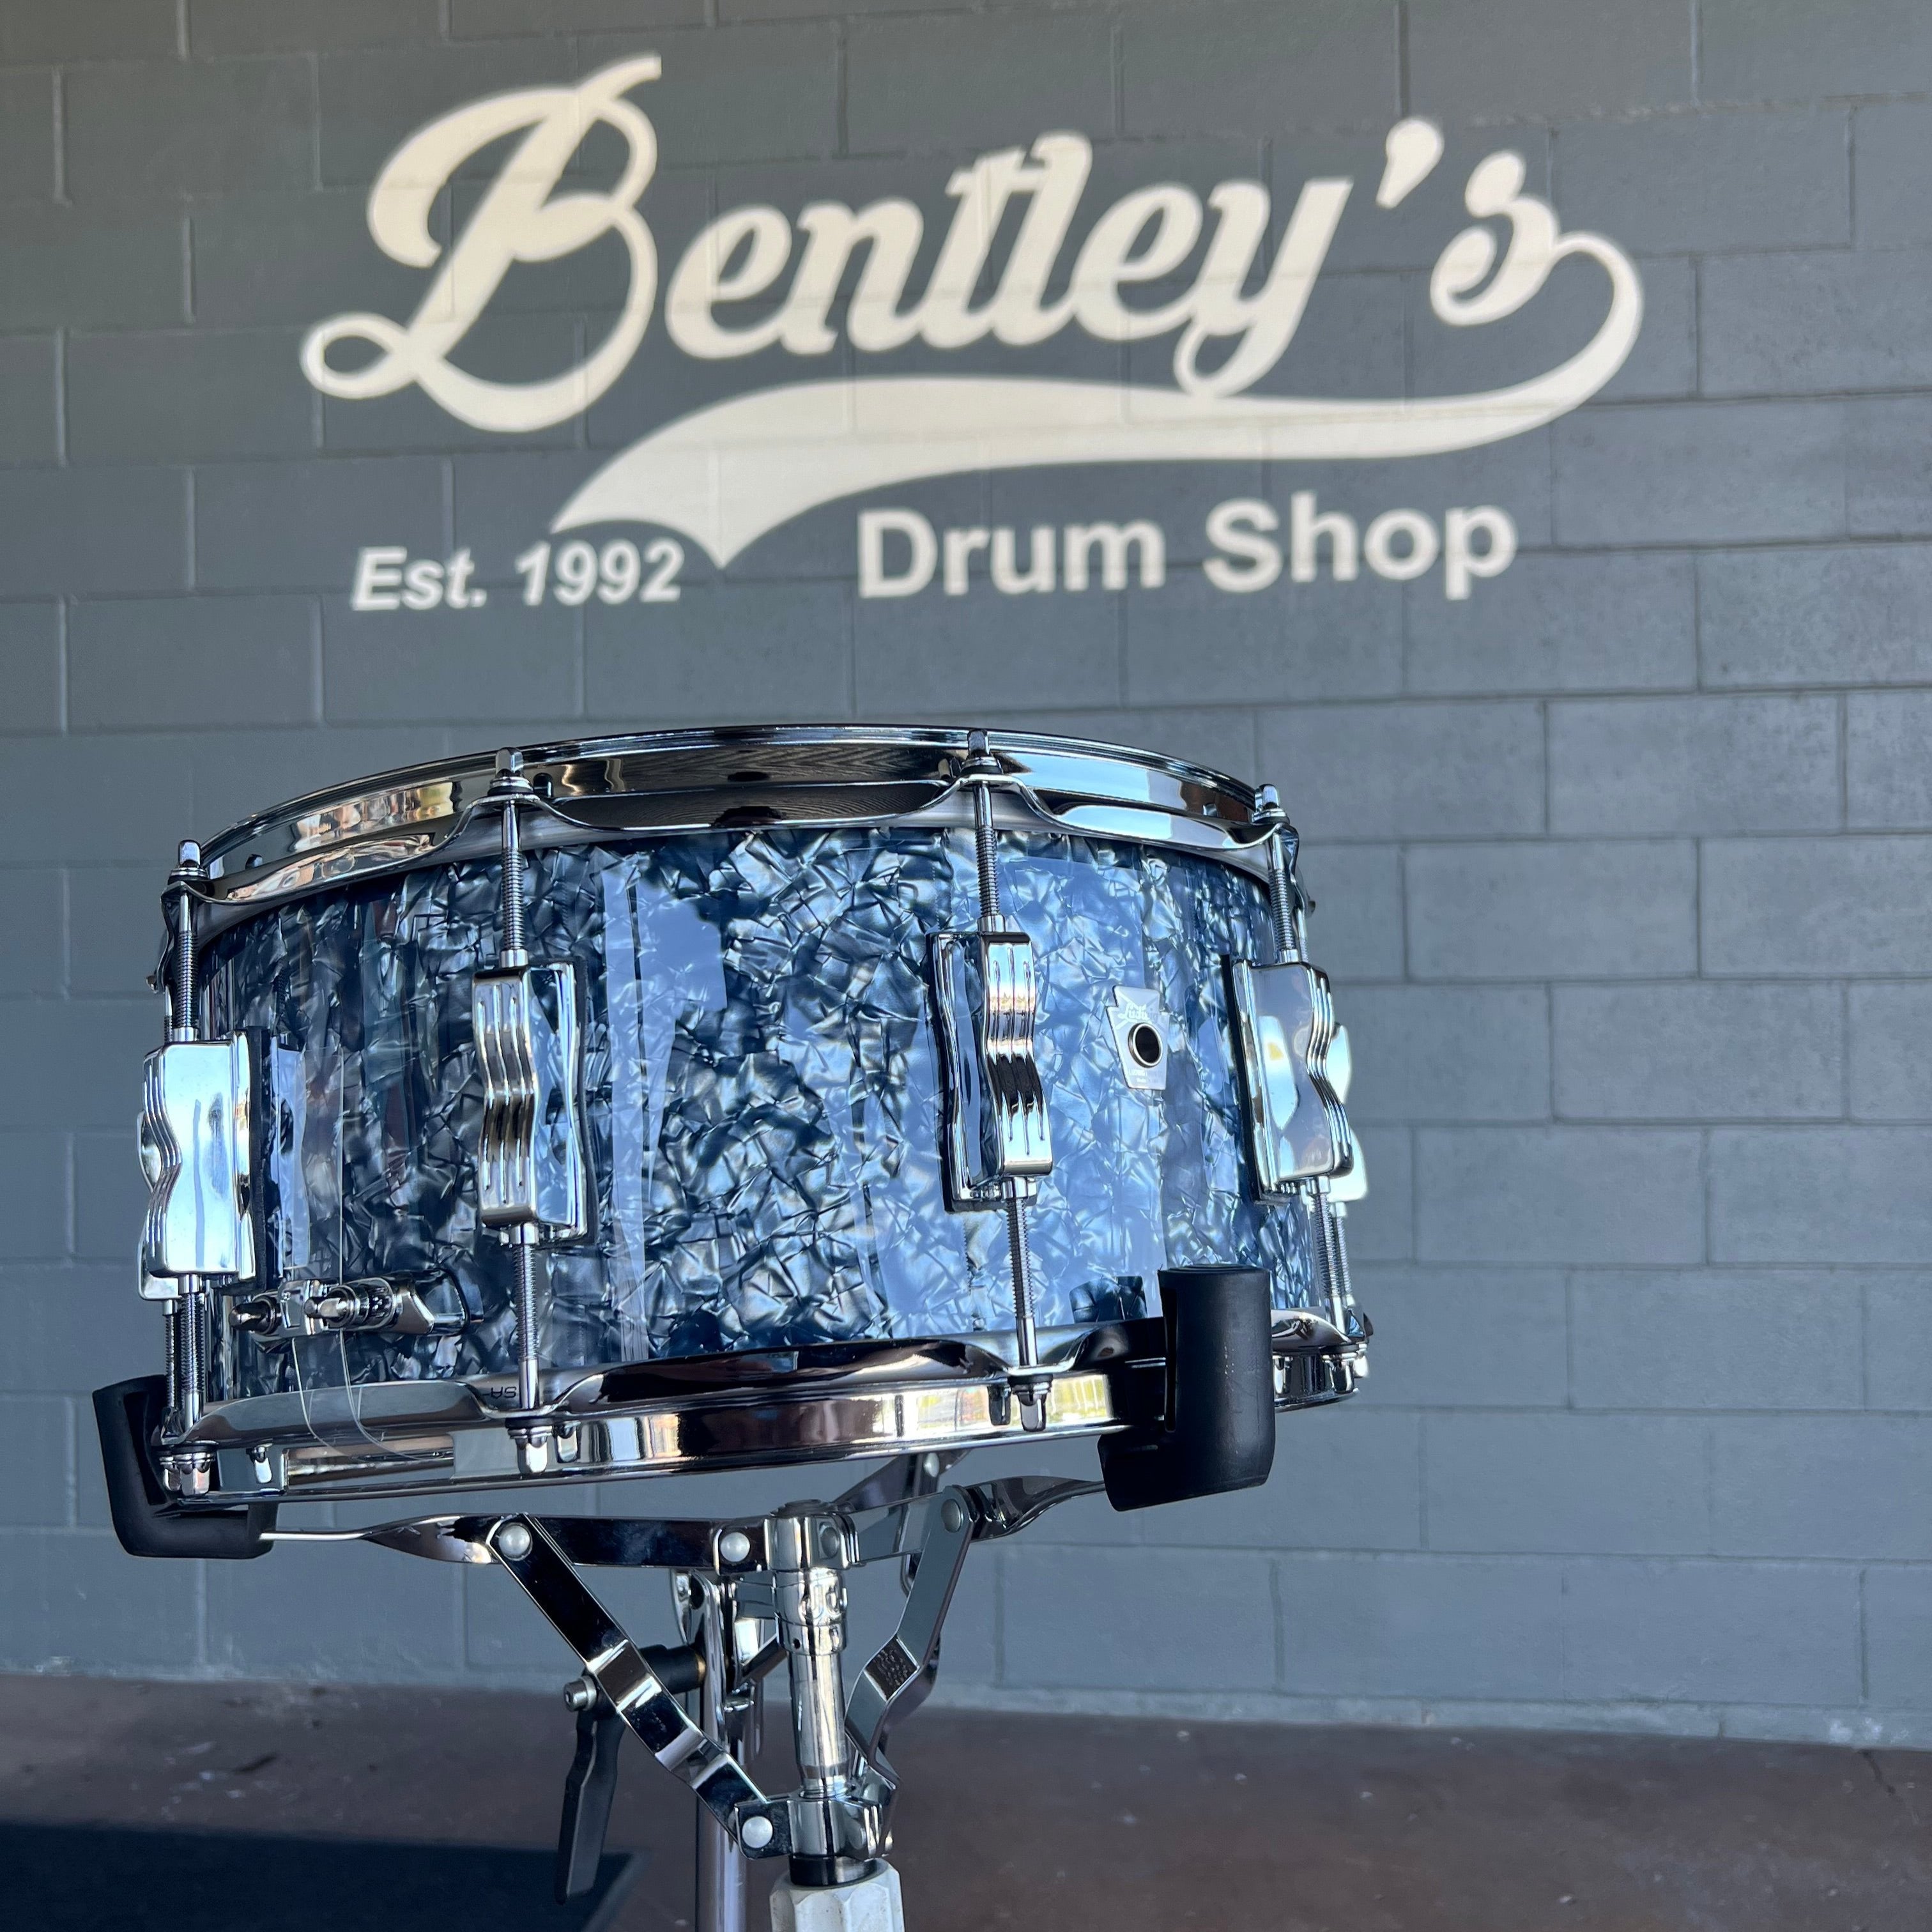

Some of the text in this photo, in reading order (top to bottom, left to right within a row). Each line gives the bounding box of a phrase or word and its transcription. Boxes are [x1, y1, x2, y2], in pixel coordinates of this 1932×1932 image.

[301, 53, 1584, 433] Bentley's
[351, 537, 686, 611] Est. 1992
[859, 491, 1517, 600] Drum Shop
